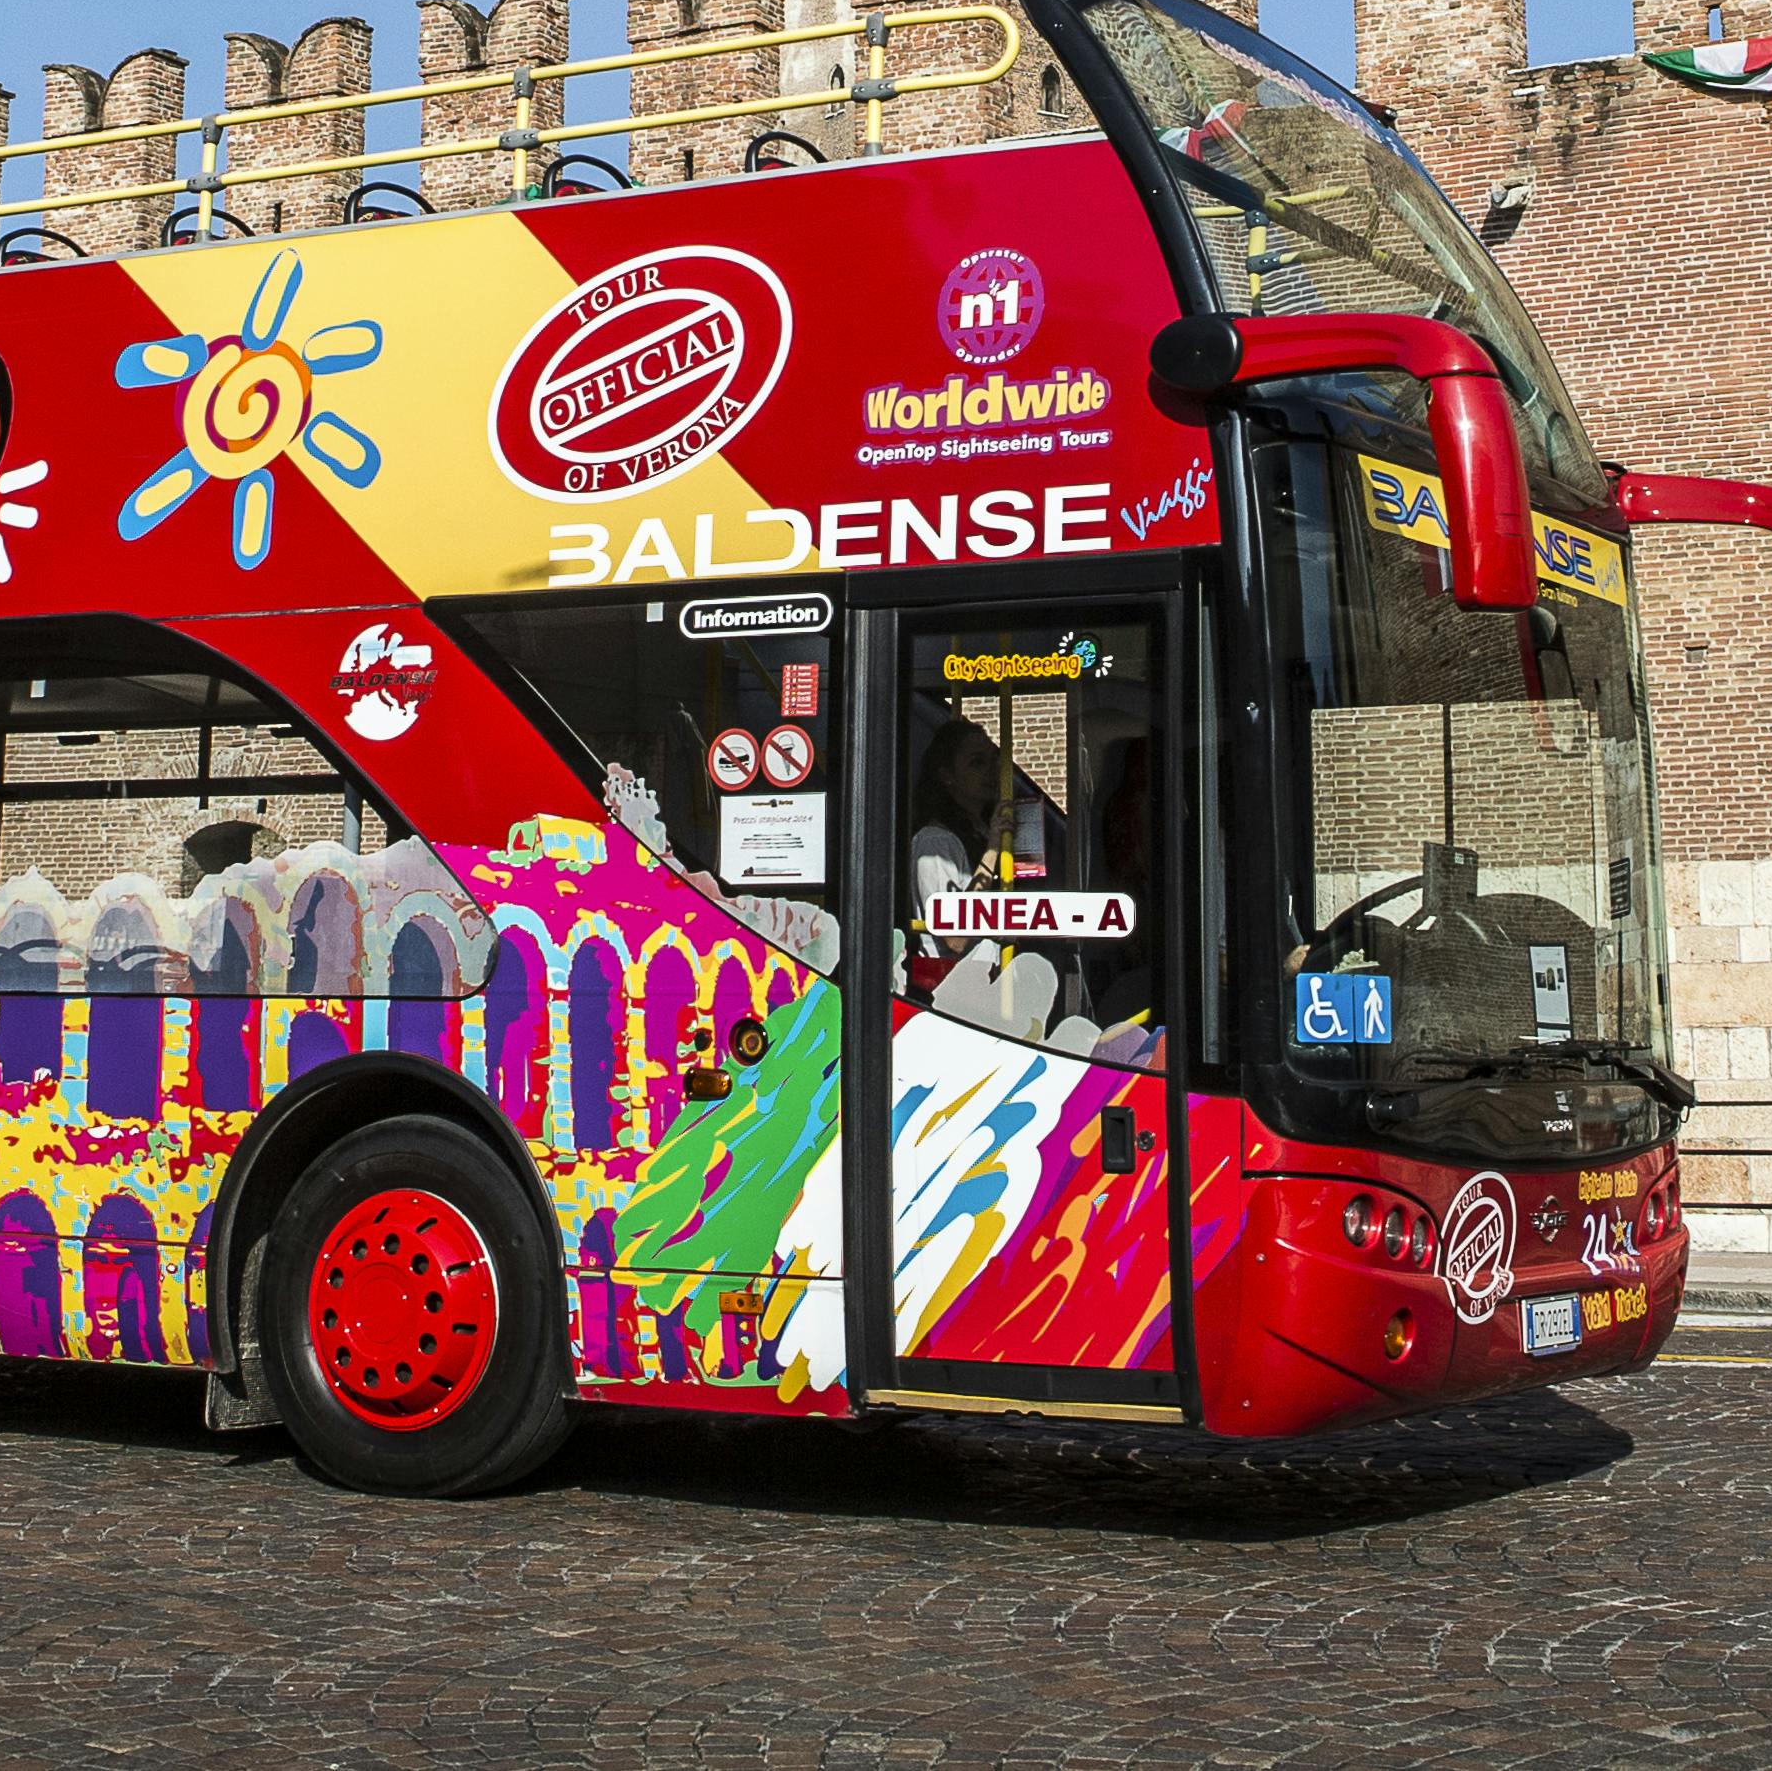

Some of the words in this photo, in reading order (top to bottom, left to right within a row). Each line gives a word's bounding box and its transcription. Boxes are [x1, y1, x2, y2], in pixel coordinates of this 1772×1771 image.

[960, 249, 1025, 269] Operator
[567, 266, 665, 327] TOUR
[543, 317, 735, 431] OFFICIAL
[955, 343, 1021, 364] Operador
[866, 370, 1106, 430] Worldwide
[563, 462, 607, 493] OF
[618, 395, 746, 485] VERONA
[857, 443, 936, 466] OpenTop
[940, 434, 1053, 460] Sightseeing
[1060, 430, 1110, 447] Tours
[547, 483, 1112, 586] BALDENSE
[1120, 457, 1214, 541] Viaggi
[693, 604, 820, 629] Information
[932, 898, 1059, 930] LINEA
[1098, 898, 1128, 931] A
[1455, 1182, 1484, 1217] TOUR
[1449, 1217, 1502, 1281] OFFICIAL
[1581, 1213, 1615, 1276] 24
[1469, 1298, 1481, 1317] OF
